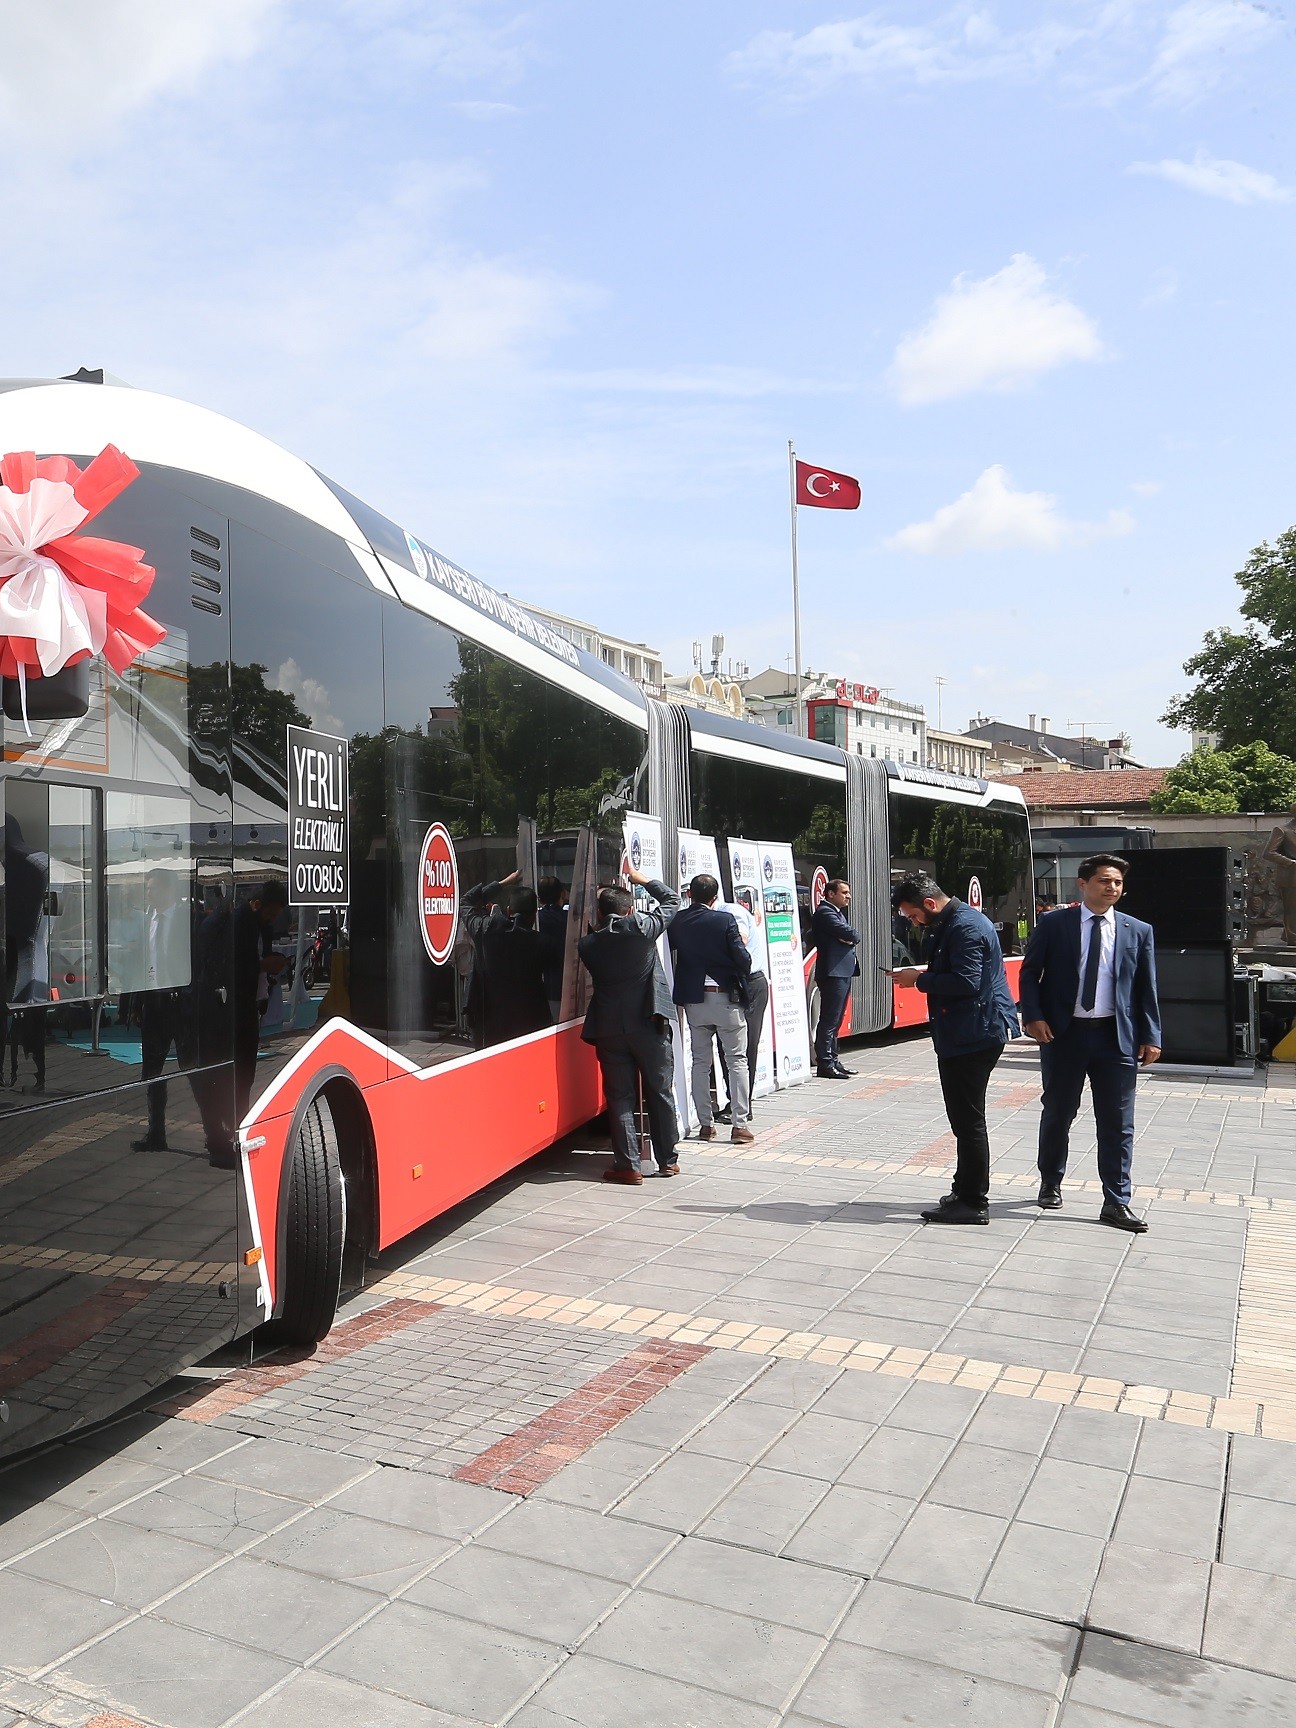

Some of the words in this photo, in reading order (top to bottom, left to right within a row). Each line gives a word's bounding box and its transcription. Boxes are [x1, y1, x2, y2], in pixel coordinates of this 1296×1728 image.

[423, 548, 479, 606] KAYSERİ
[293, 744, 344, 812] YERLİ
[294, 815, 344, 853] ELEKTRİKLİ
[295, 860, 344, 894] OTOBÜS
[424, 859, 452, 889] %100
[424, 891, 454, 915] ELEKTRİKLİ
